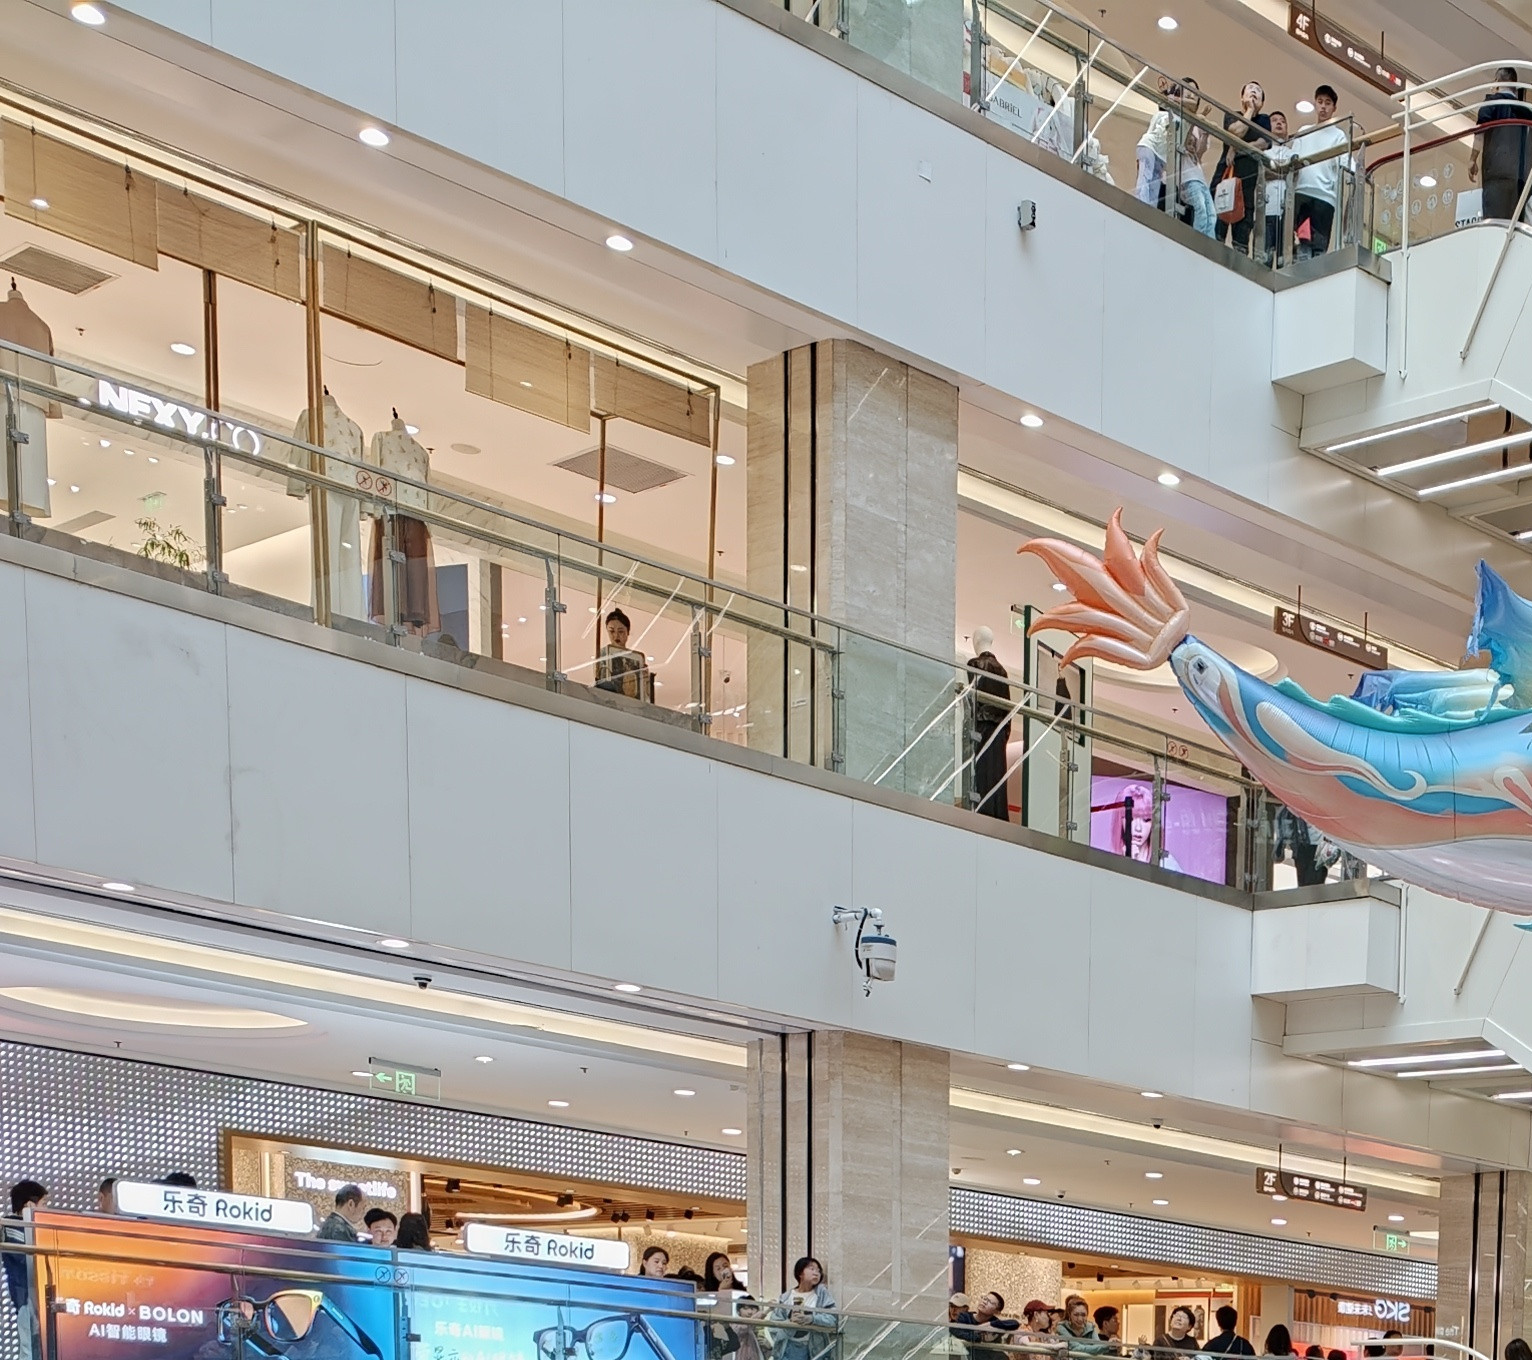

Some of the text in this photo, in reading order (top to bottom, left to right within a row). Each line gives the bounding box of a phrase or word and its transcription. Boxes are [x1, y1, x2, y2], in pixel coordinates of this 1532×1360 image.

[1296, 13, 1310, 31] 4F
[1281, 611, 1295, 628] 3F
[294, 1171, 326, 1190] The
[1264, 1171, 1277, 1186] 2F
[163, 1190, 272, 1222] 乐奇 Rokid
[504, 1233, 595, 1260] 乐奇 Rokid
[83, 1300, 125, 1317] Rokid
[139, 1305, 204, 1324] BOLON
[88, 1323, 168, 1343] AI智能眼镜
